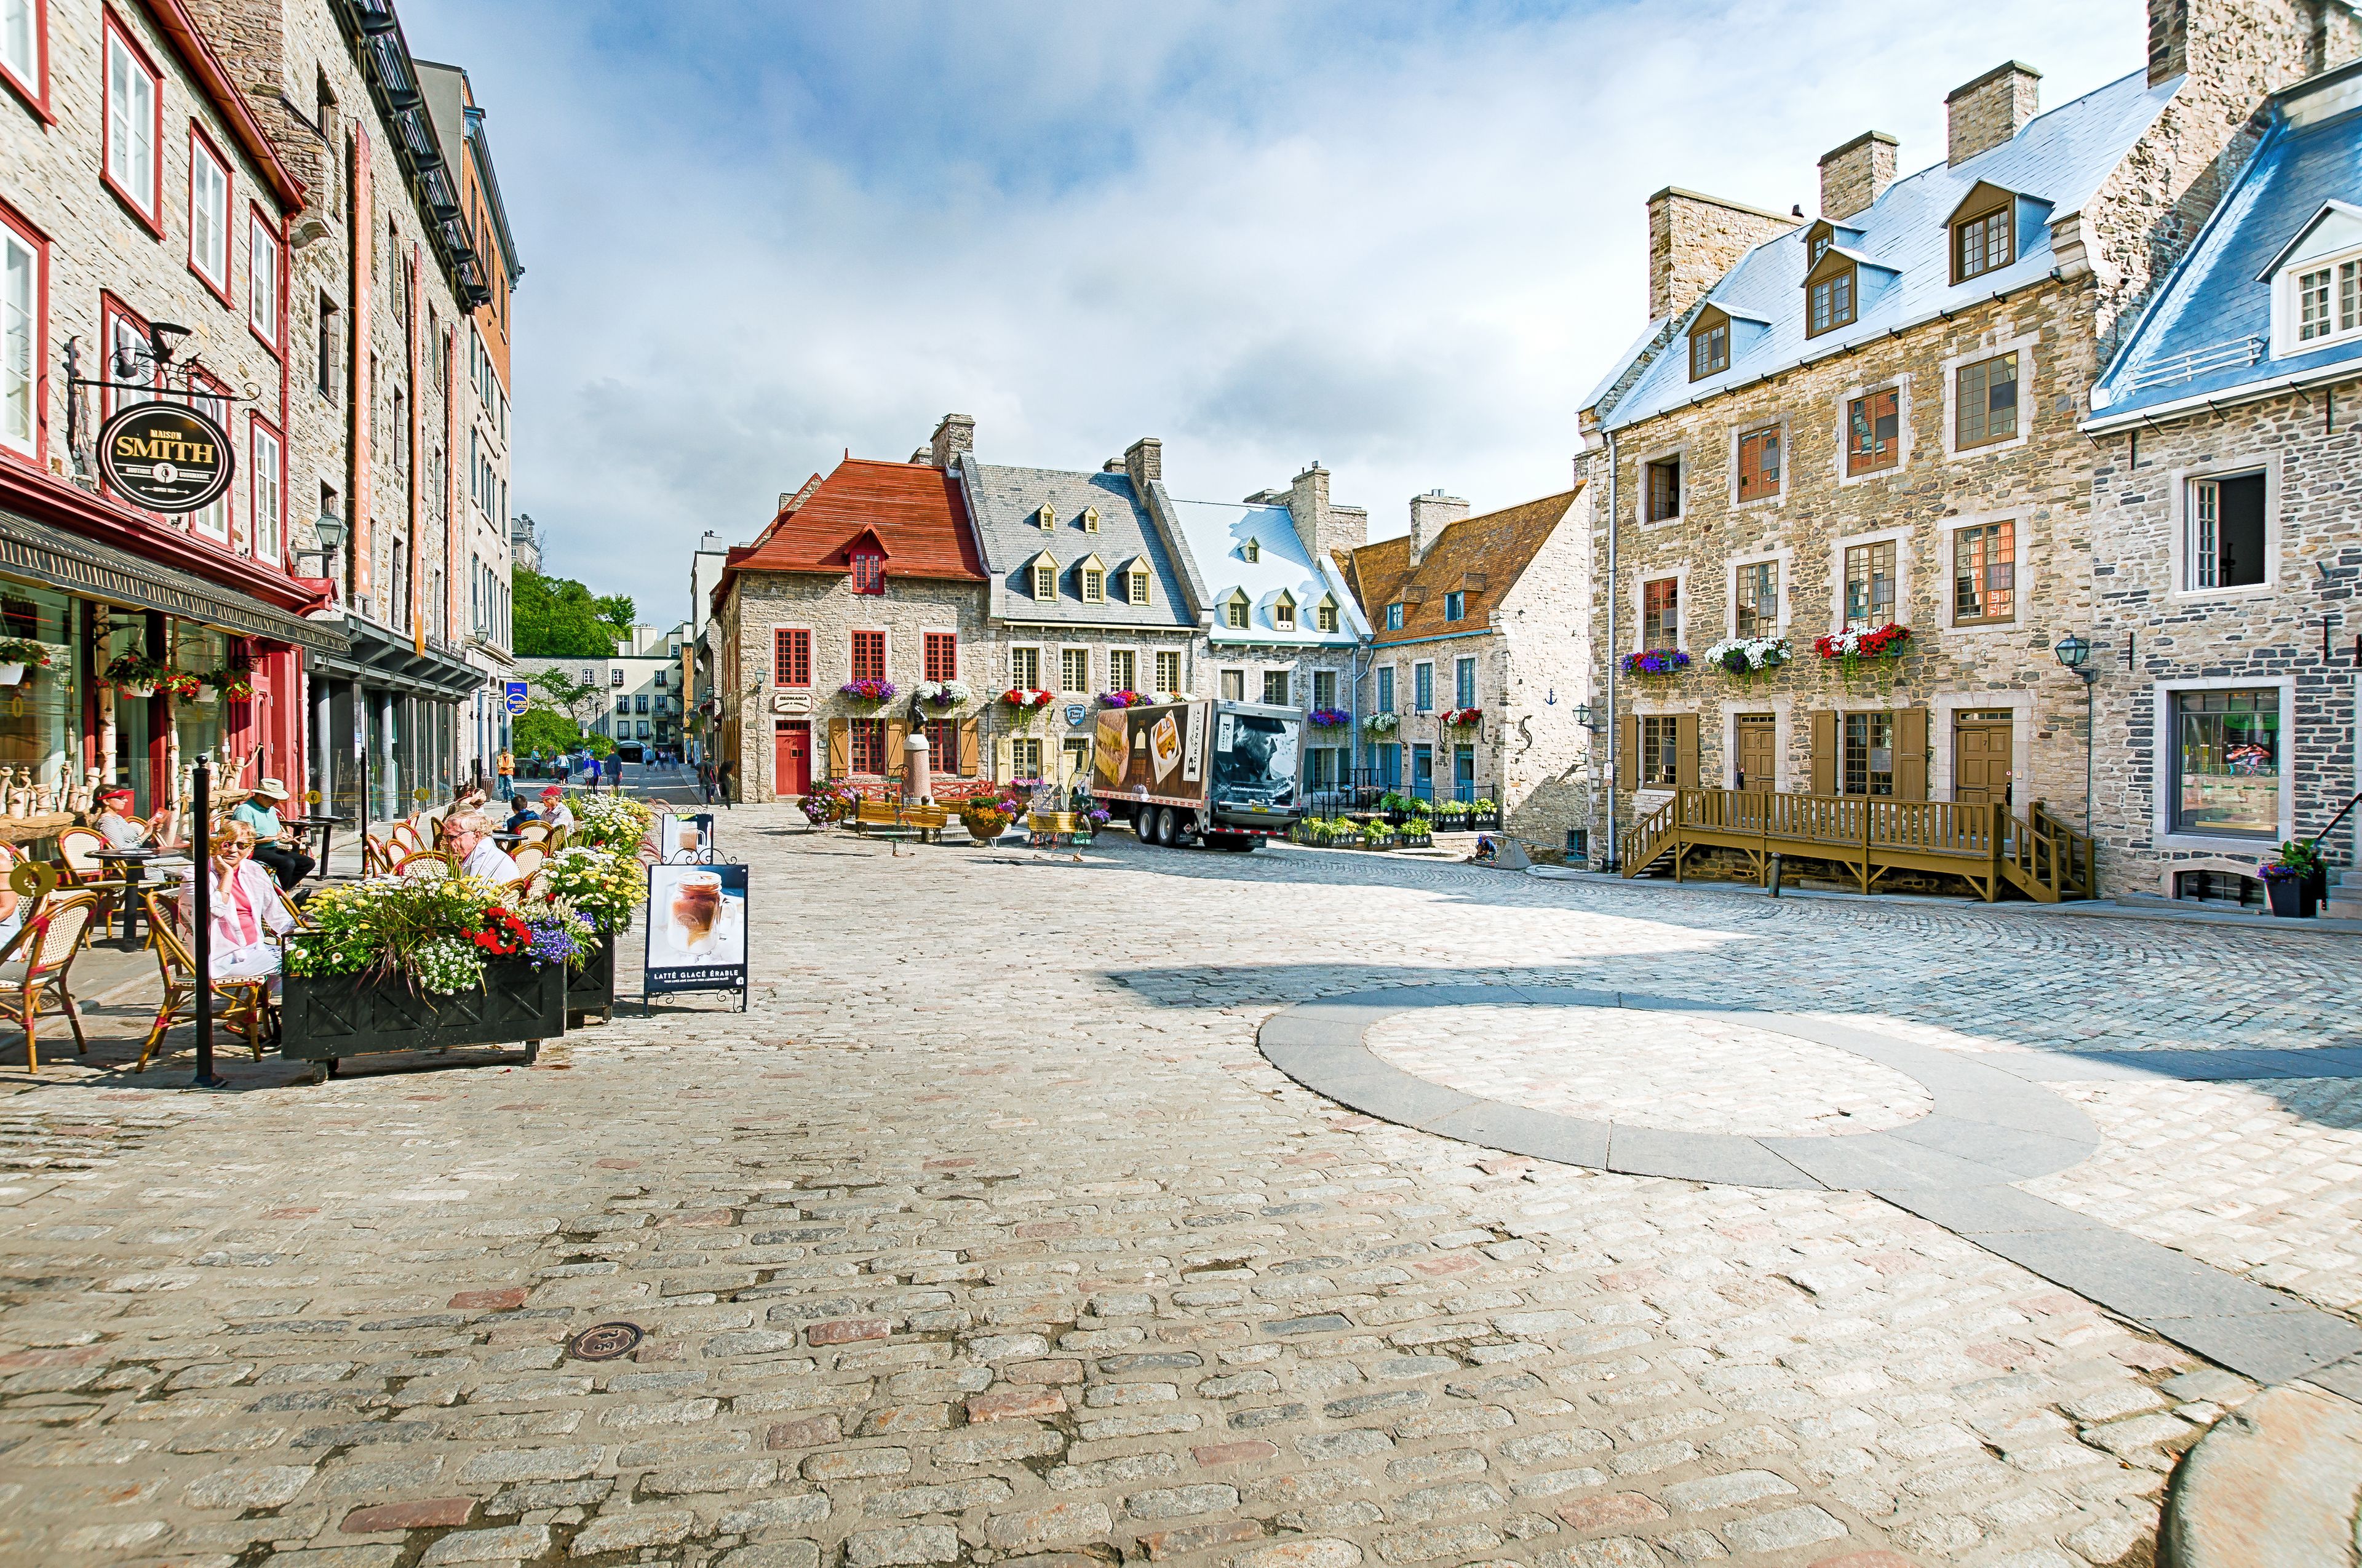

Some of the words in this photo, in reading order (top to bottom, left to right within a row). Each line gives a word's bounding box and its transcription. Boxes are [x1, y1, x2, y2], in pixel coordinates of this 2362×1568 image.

[149, 429, 182, 440] MAISON
[116, 436, 215, 464] SMITH
[417, 501, 422, 527] DE
[2233, 714, 2272, 723] JADE
[654, 971, 677, 979] LATTÉ
[680, 970, 706, 979] GLACÉ
